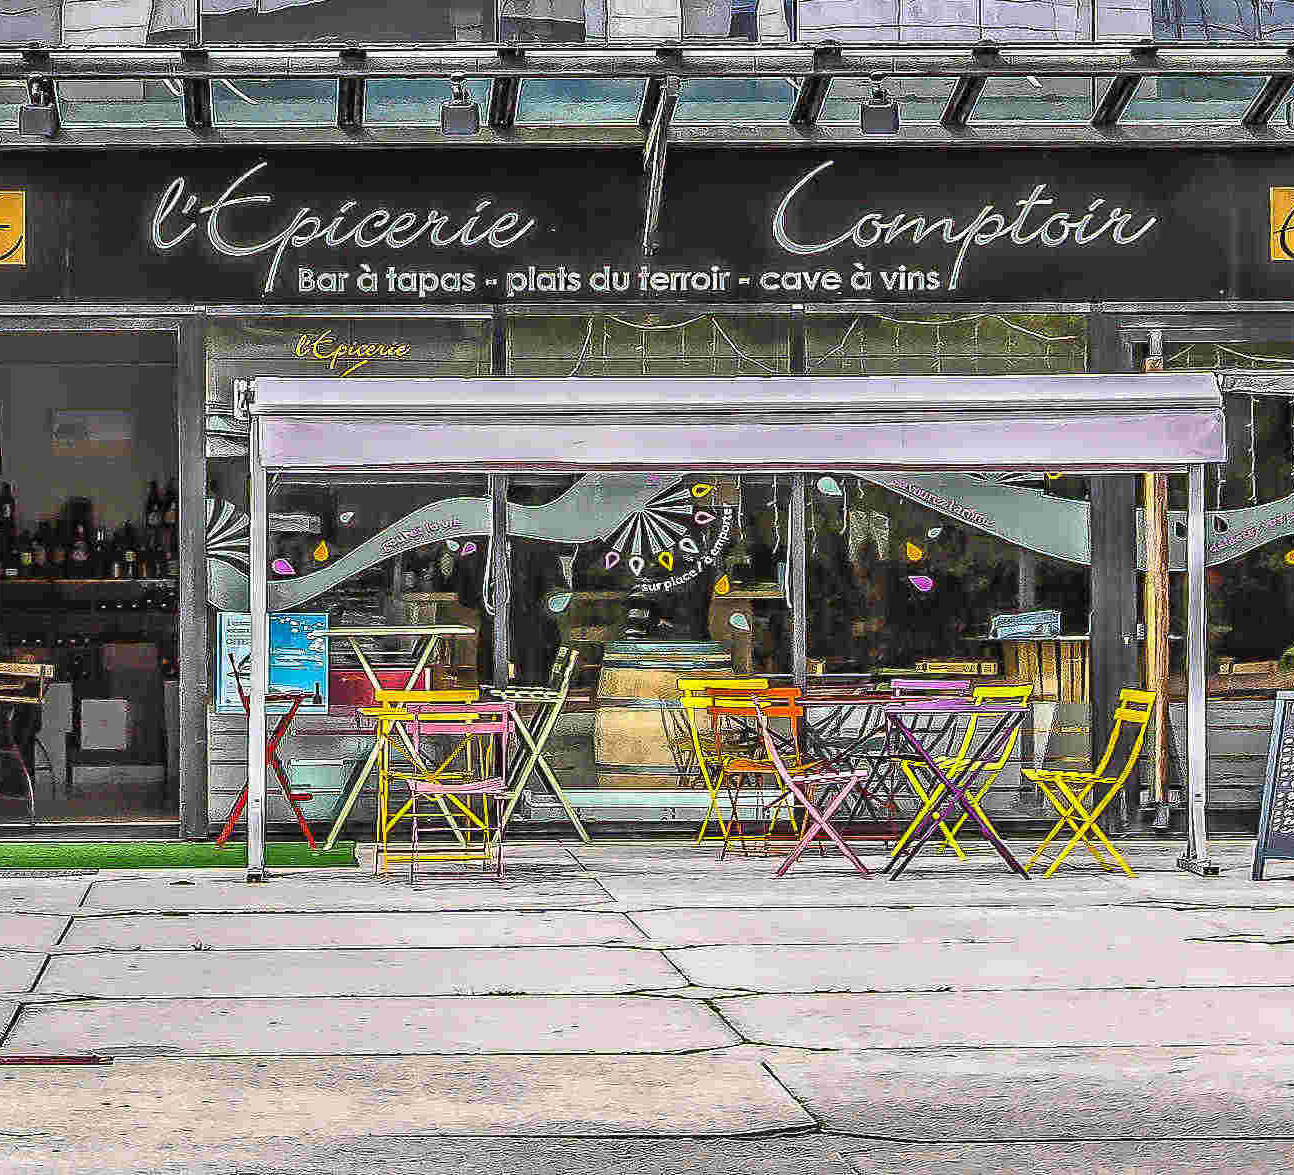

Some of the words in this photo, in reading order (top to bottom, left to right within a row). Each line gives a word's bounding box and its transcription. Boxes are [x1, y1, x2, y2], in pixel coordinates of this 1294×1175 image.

[773, 160, 1157, 291] Comptoir
[297, 267, 349, 292] Bar
[356, 263, 378, 292] à
[385, 266, 476, 297] tapas
[505, 266, 581, 297] plats
[589, 264, 631, 292] du
[637, 265, 731, 292] terroir
[758, 271, 843, 292] cave
[849, 263, 872, 291] à
[879, 265, 940, 291] vins
